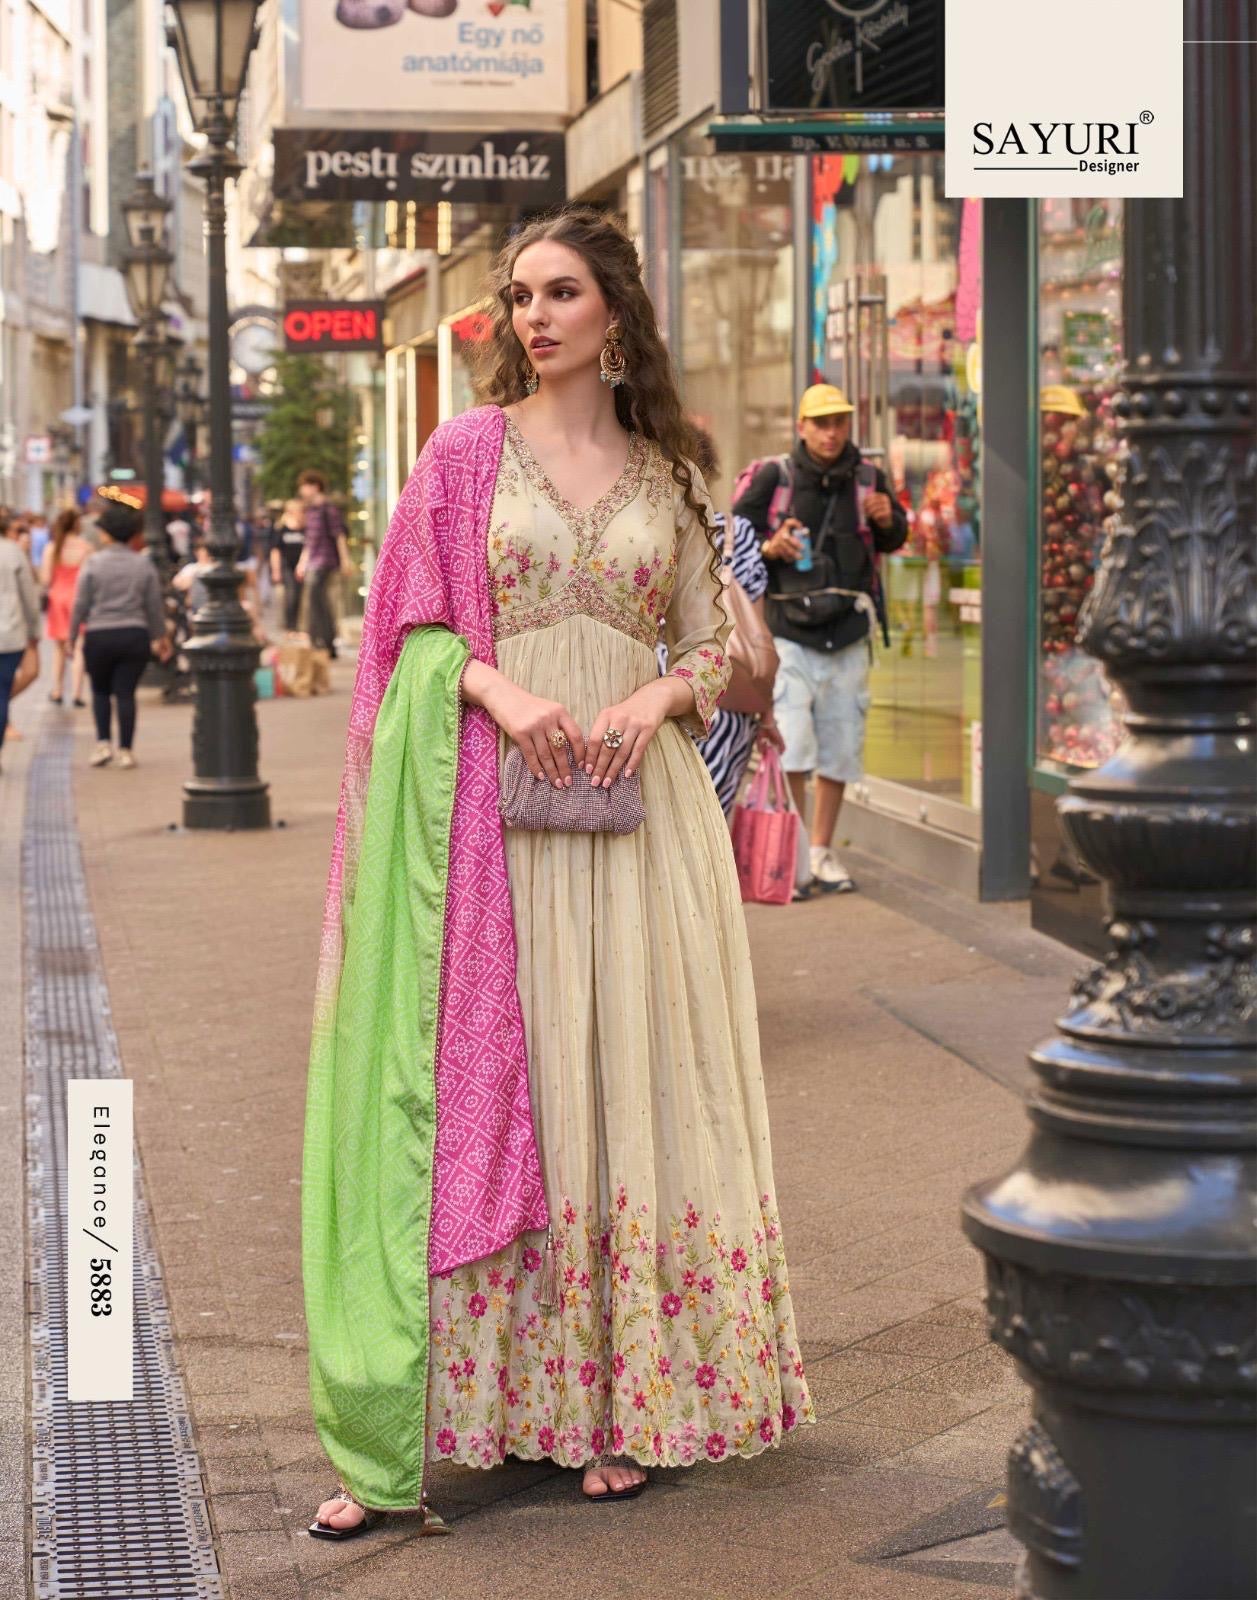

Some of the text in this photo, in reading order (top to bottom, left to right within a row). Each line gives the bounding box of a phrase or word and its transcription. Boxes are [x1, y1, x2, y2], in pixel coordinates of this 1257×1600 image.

[458, 22, 544, 48] Egy nő
[402, 52, 544, 79] anatómiája
[304, 141, 550, 192] pesti színház
[284, 310, 376, 341] OPEN
